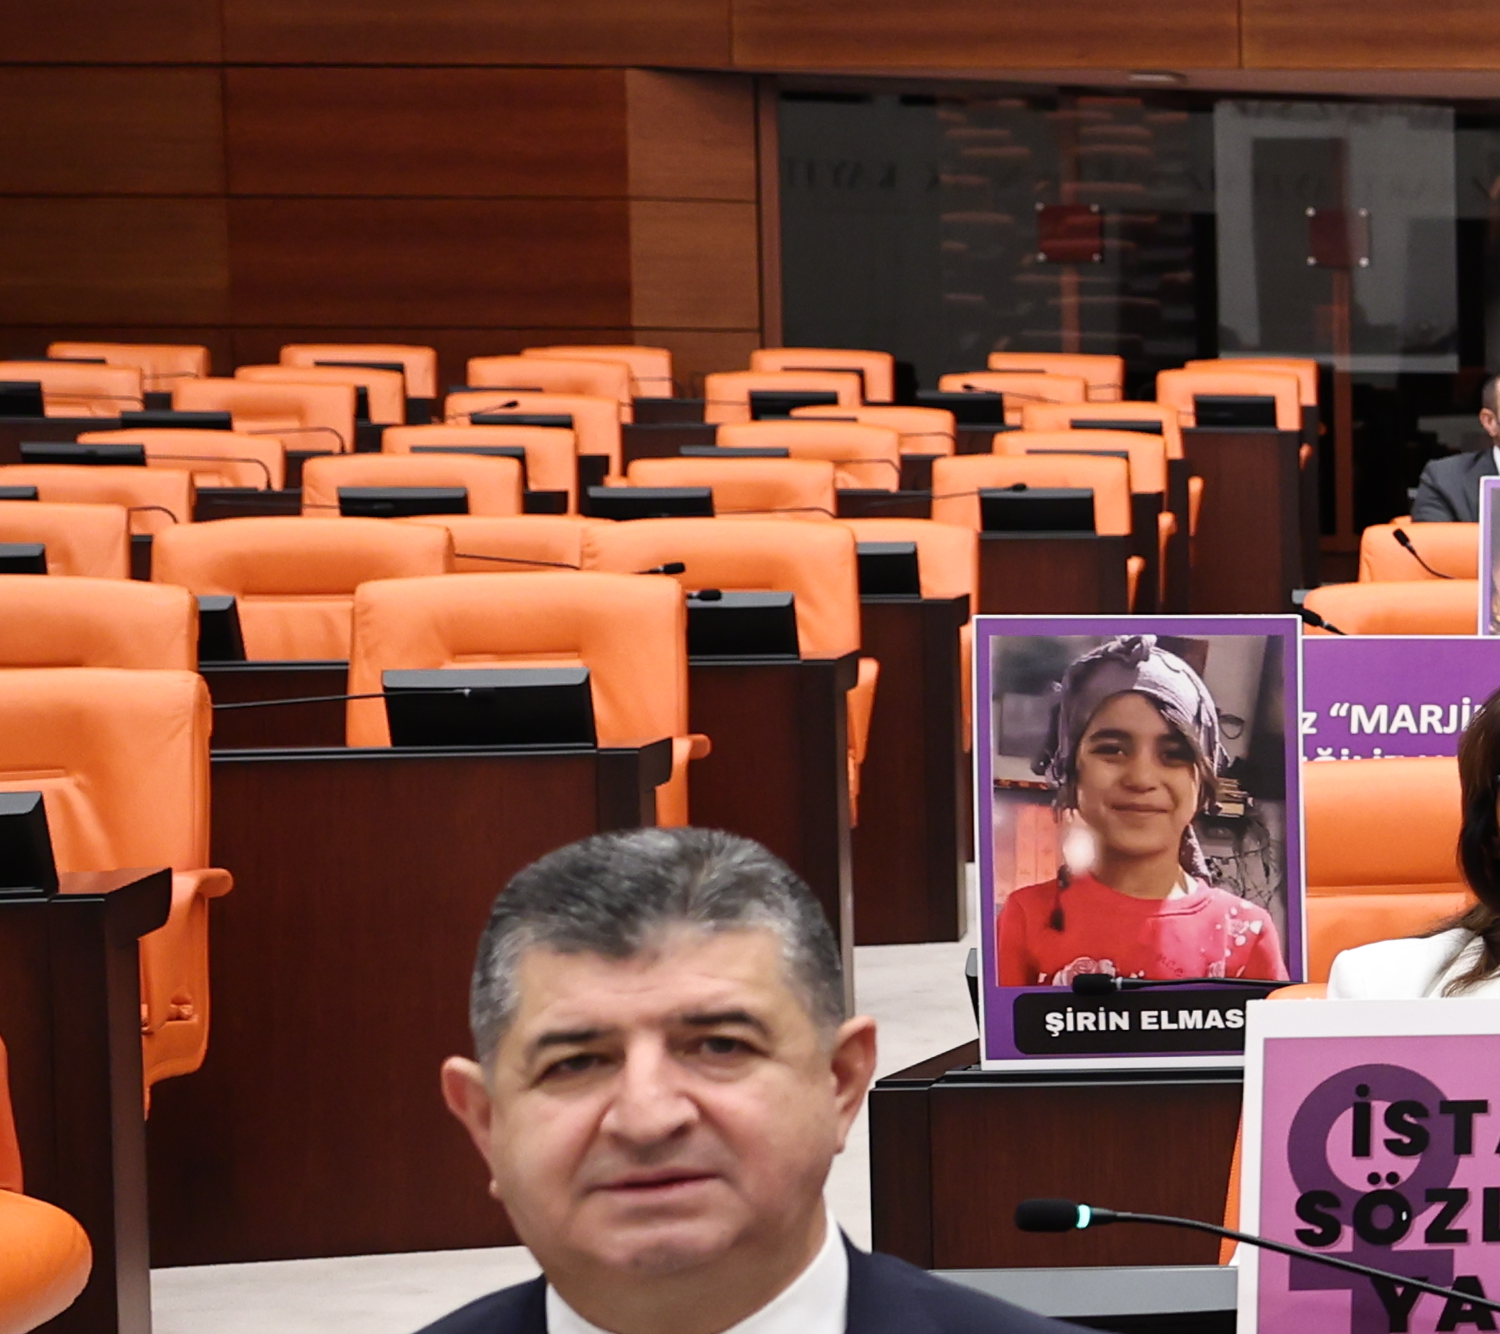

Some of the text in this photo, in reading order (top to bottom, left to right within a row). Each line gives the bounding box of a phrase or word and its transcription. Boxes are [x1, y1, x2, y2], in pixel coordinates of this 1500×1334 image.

[1329, 696, 1483, 735] “MARJİ
[1045, 1007, 1244, 1037] ŞİRİN ELMAS
